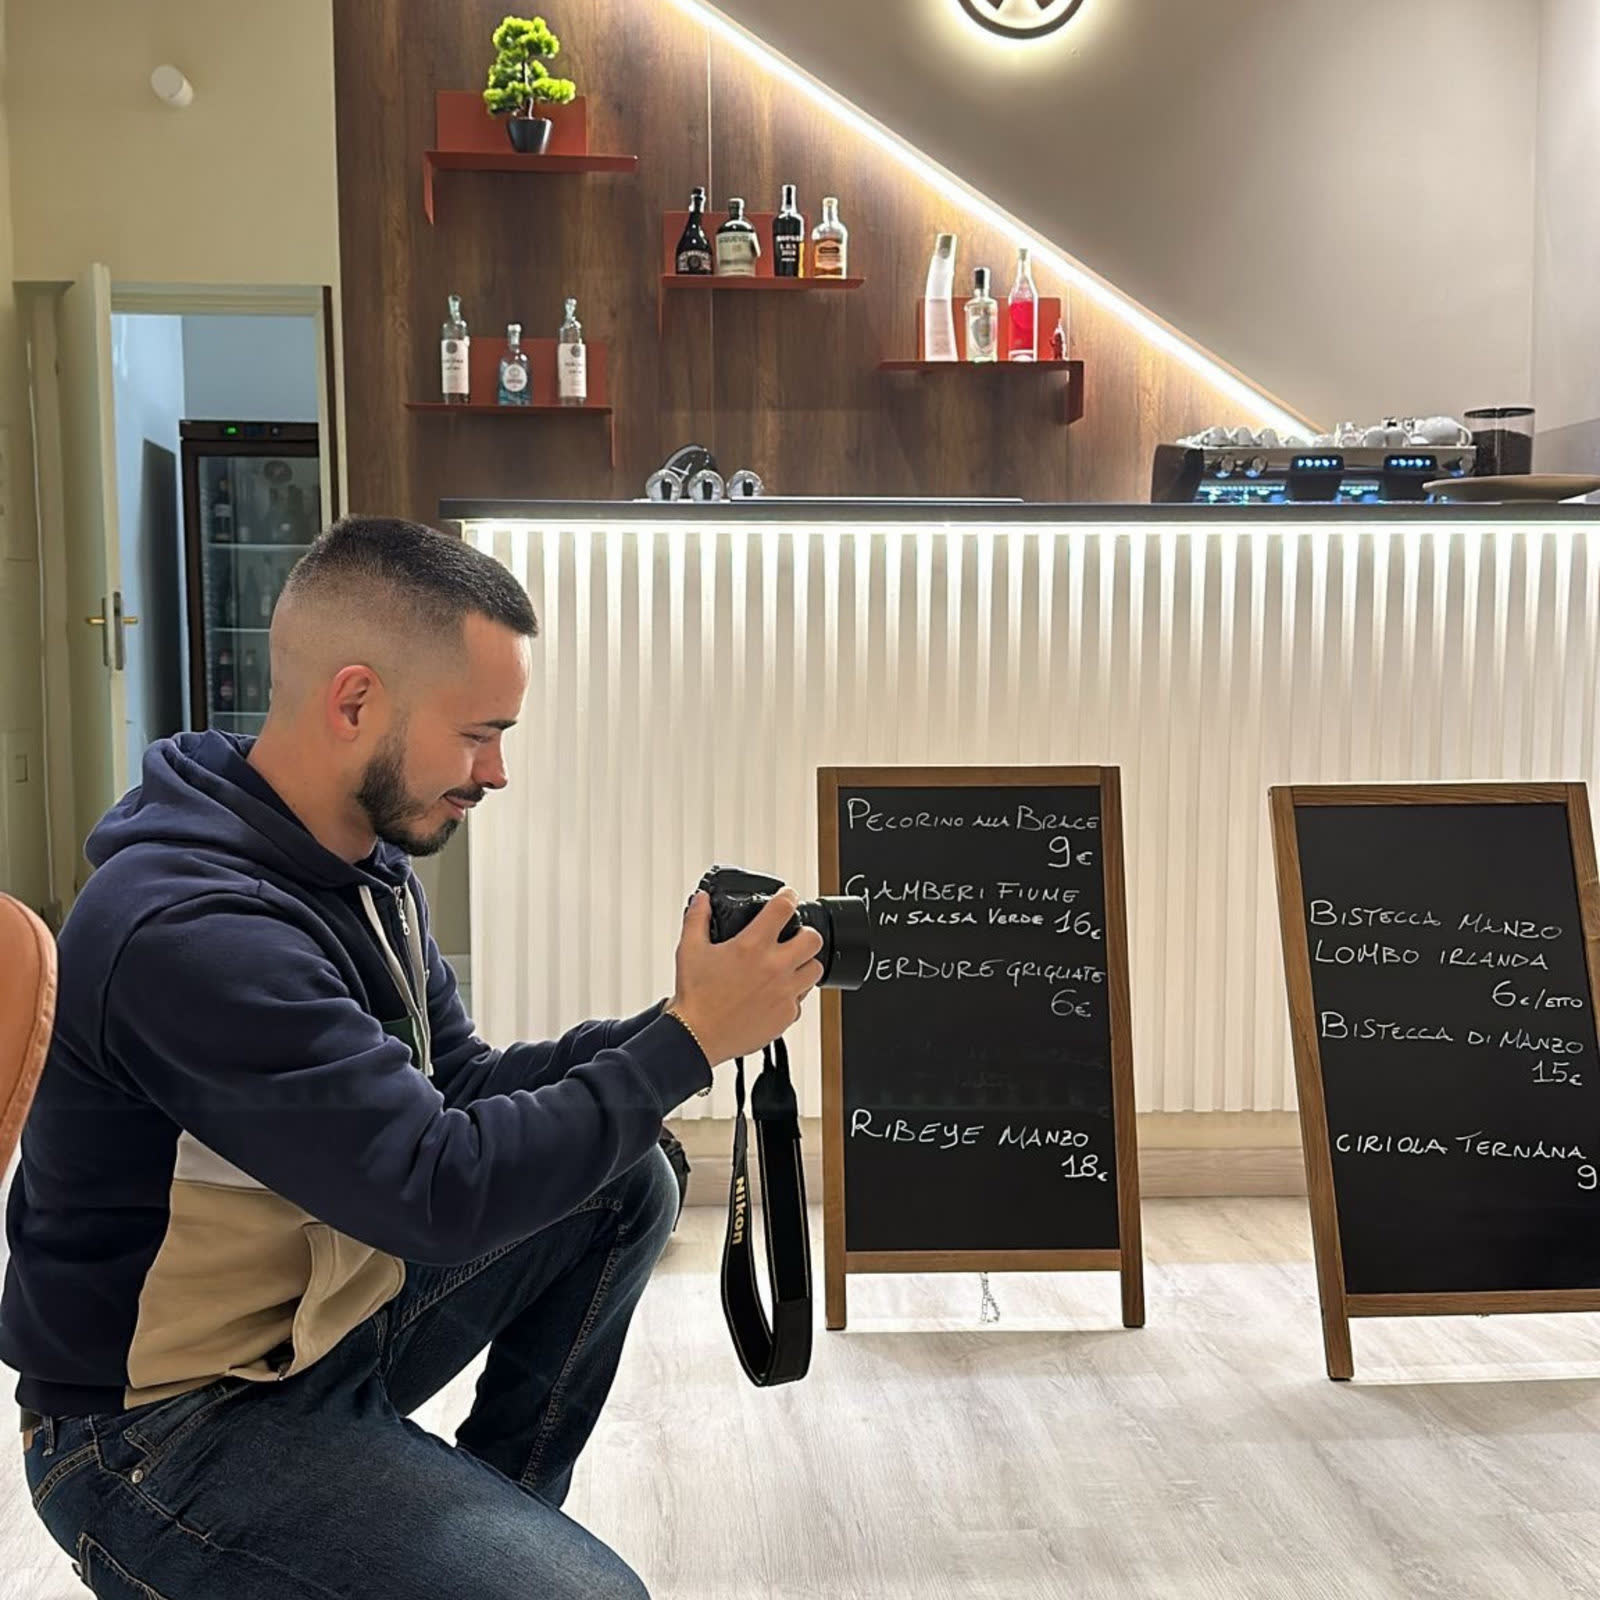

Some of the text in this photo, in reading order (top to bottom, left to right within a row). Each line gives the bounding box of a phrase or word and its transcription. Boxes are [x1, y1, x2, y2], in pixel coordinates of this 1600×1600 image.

[847, 798, 963, 831] PECORINO
[1017, 806, 1099, 830] BRACE
[845, 875, 1079, 912] GAMBERI FIUME
[880, 912, 898, 925] IN
[907, 911, 977, 924] SALSA
[1311, 900, 1562, 939] BISTECCA MANZO
[1315, 940, 1548, 970] LOMBO IRLANDA
[1007, 962, 1105, 986] GRIGLIATE
[1322, 1011, 1583, 1053] BISTECCA DI MANZO
[851, 1109, 1088, 1149] RIBEYE MANZO
[1336, 1132, 1586, 1159] CIRIOLA TERNANA
[732, 1176, 746, 1245] Nikon
